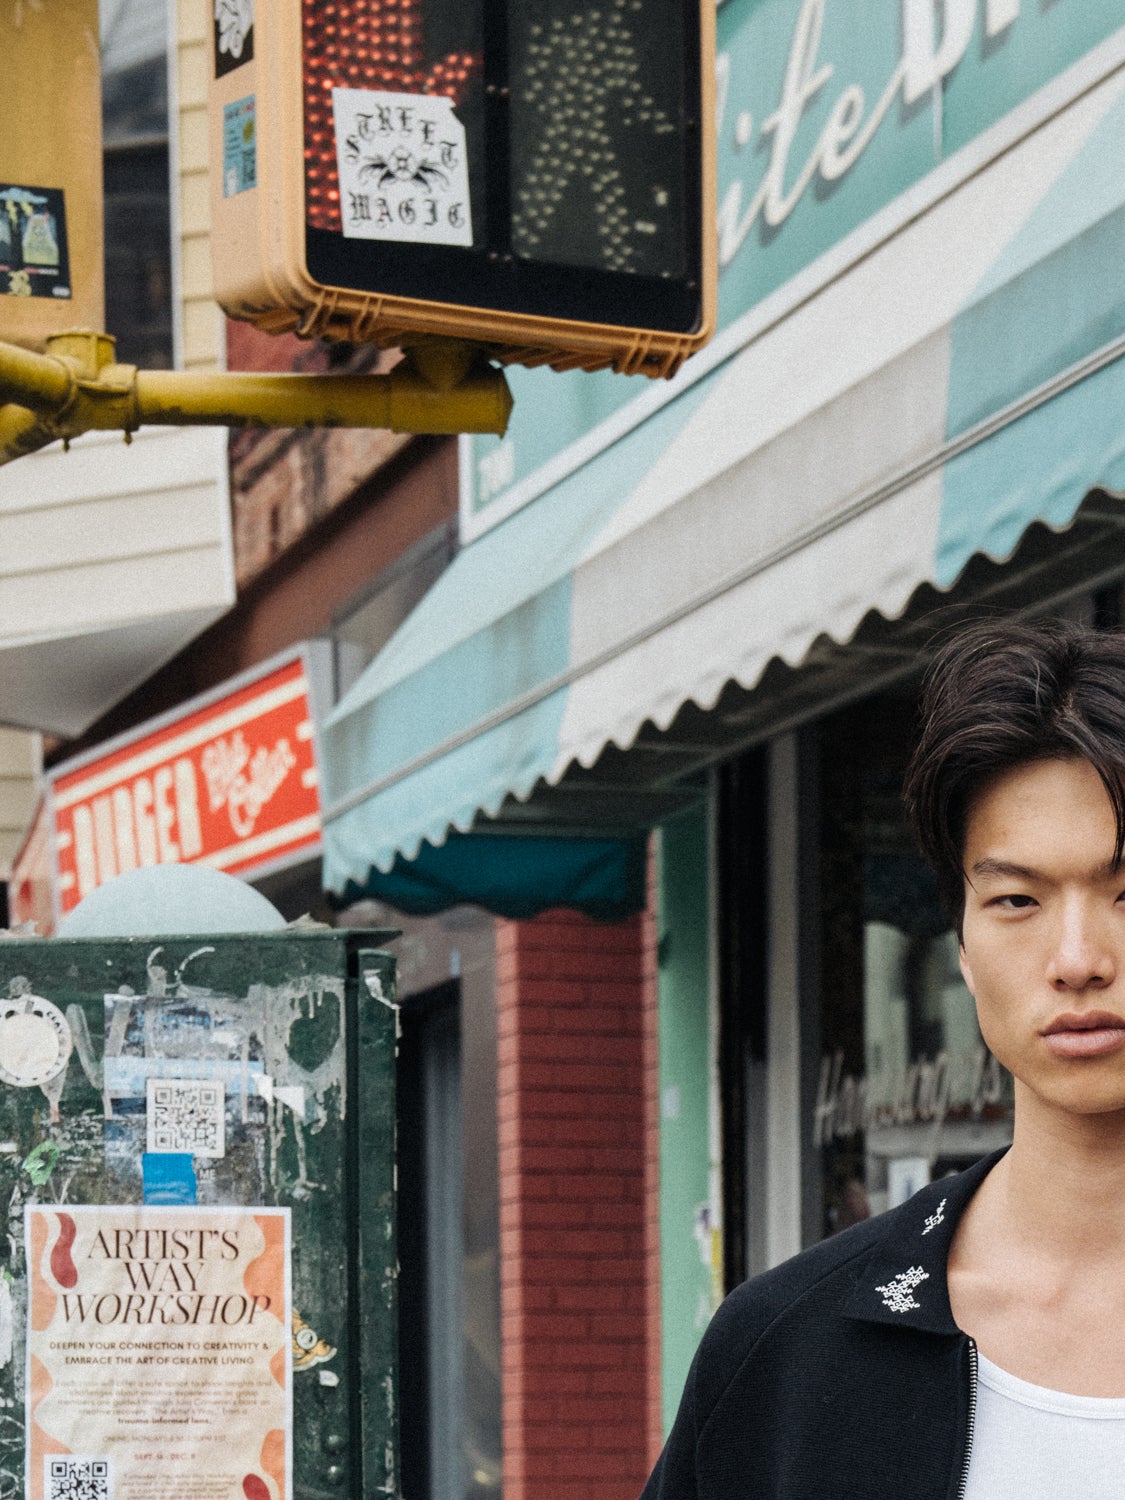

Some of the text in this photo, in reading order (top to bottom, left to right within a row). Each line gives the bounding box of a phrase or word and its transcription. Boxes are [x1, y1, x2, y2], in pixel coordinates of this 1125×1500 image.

[346, 104, 458, 168] STREET
[349, 192, 465, 228] MAGIC
[88, 1228, 240, 1260] ARTIST'S
[125, 1262, 206, 1292] WAY
[62, 1294, 272, 1326] WORKSHOP
[50, 1341, 269, 1350] DEEPEN YOUR CONNECTION TO CREATIVITY &
[65, 1356, 255, 1365] EMBRACE THE ART OF CREATIVE LIVING
